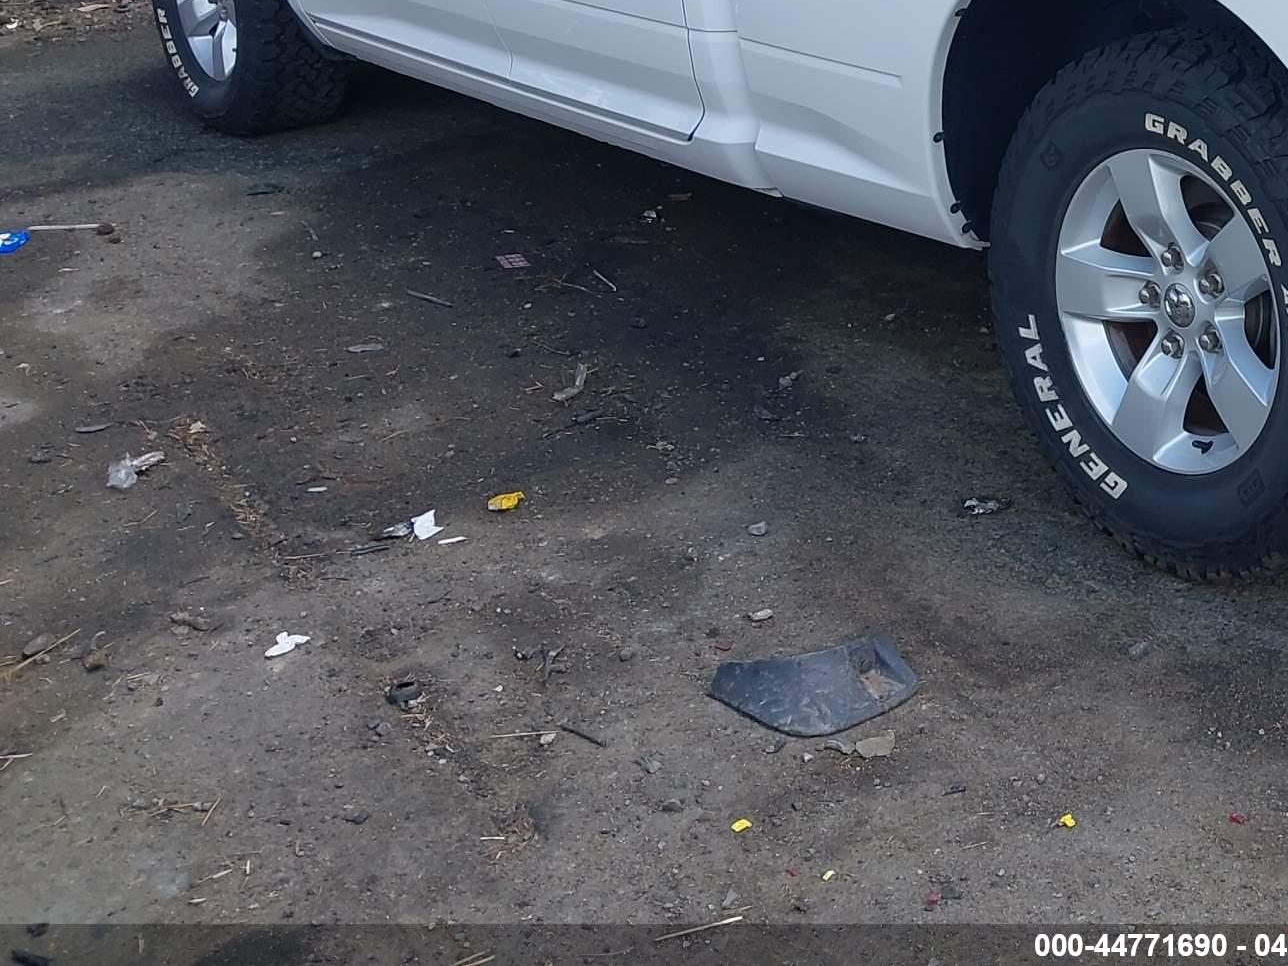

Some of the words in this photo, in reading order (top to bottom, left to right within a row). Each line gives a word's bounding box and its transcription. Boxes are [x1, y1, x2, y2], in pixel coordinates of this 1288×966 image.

[156, 7, 200, 98] GRABBER
[1144, 112, 1283, 268] GRABBER
[1017, 313, 1130, 501] GENERAL
